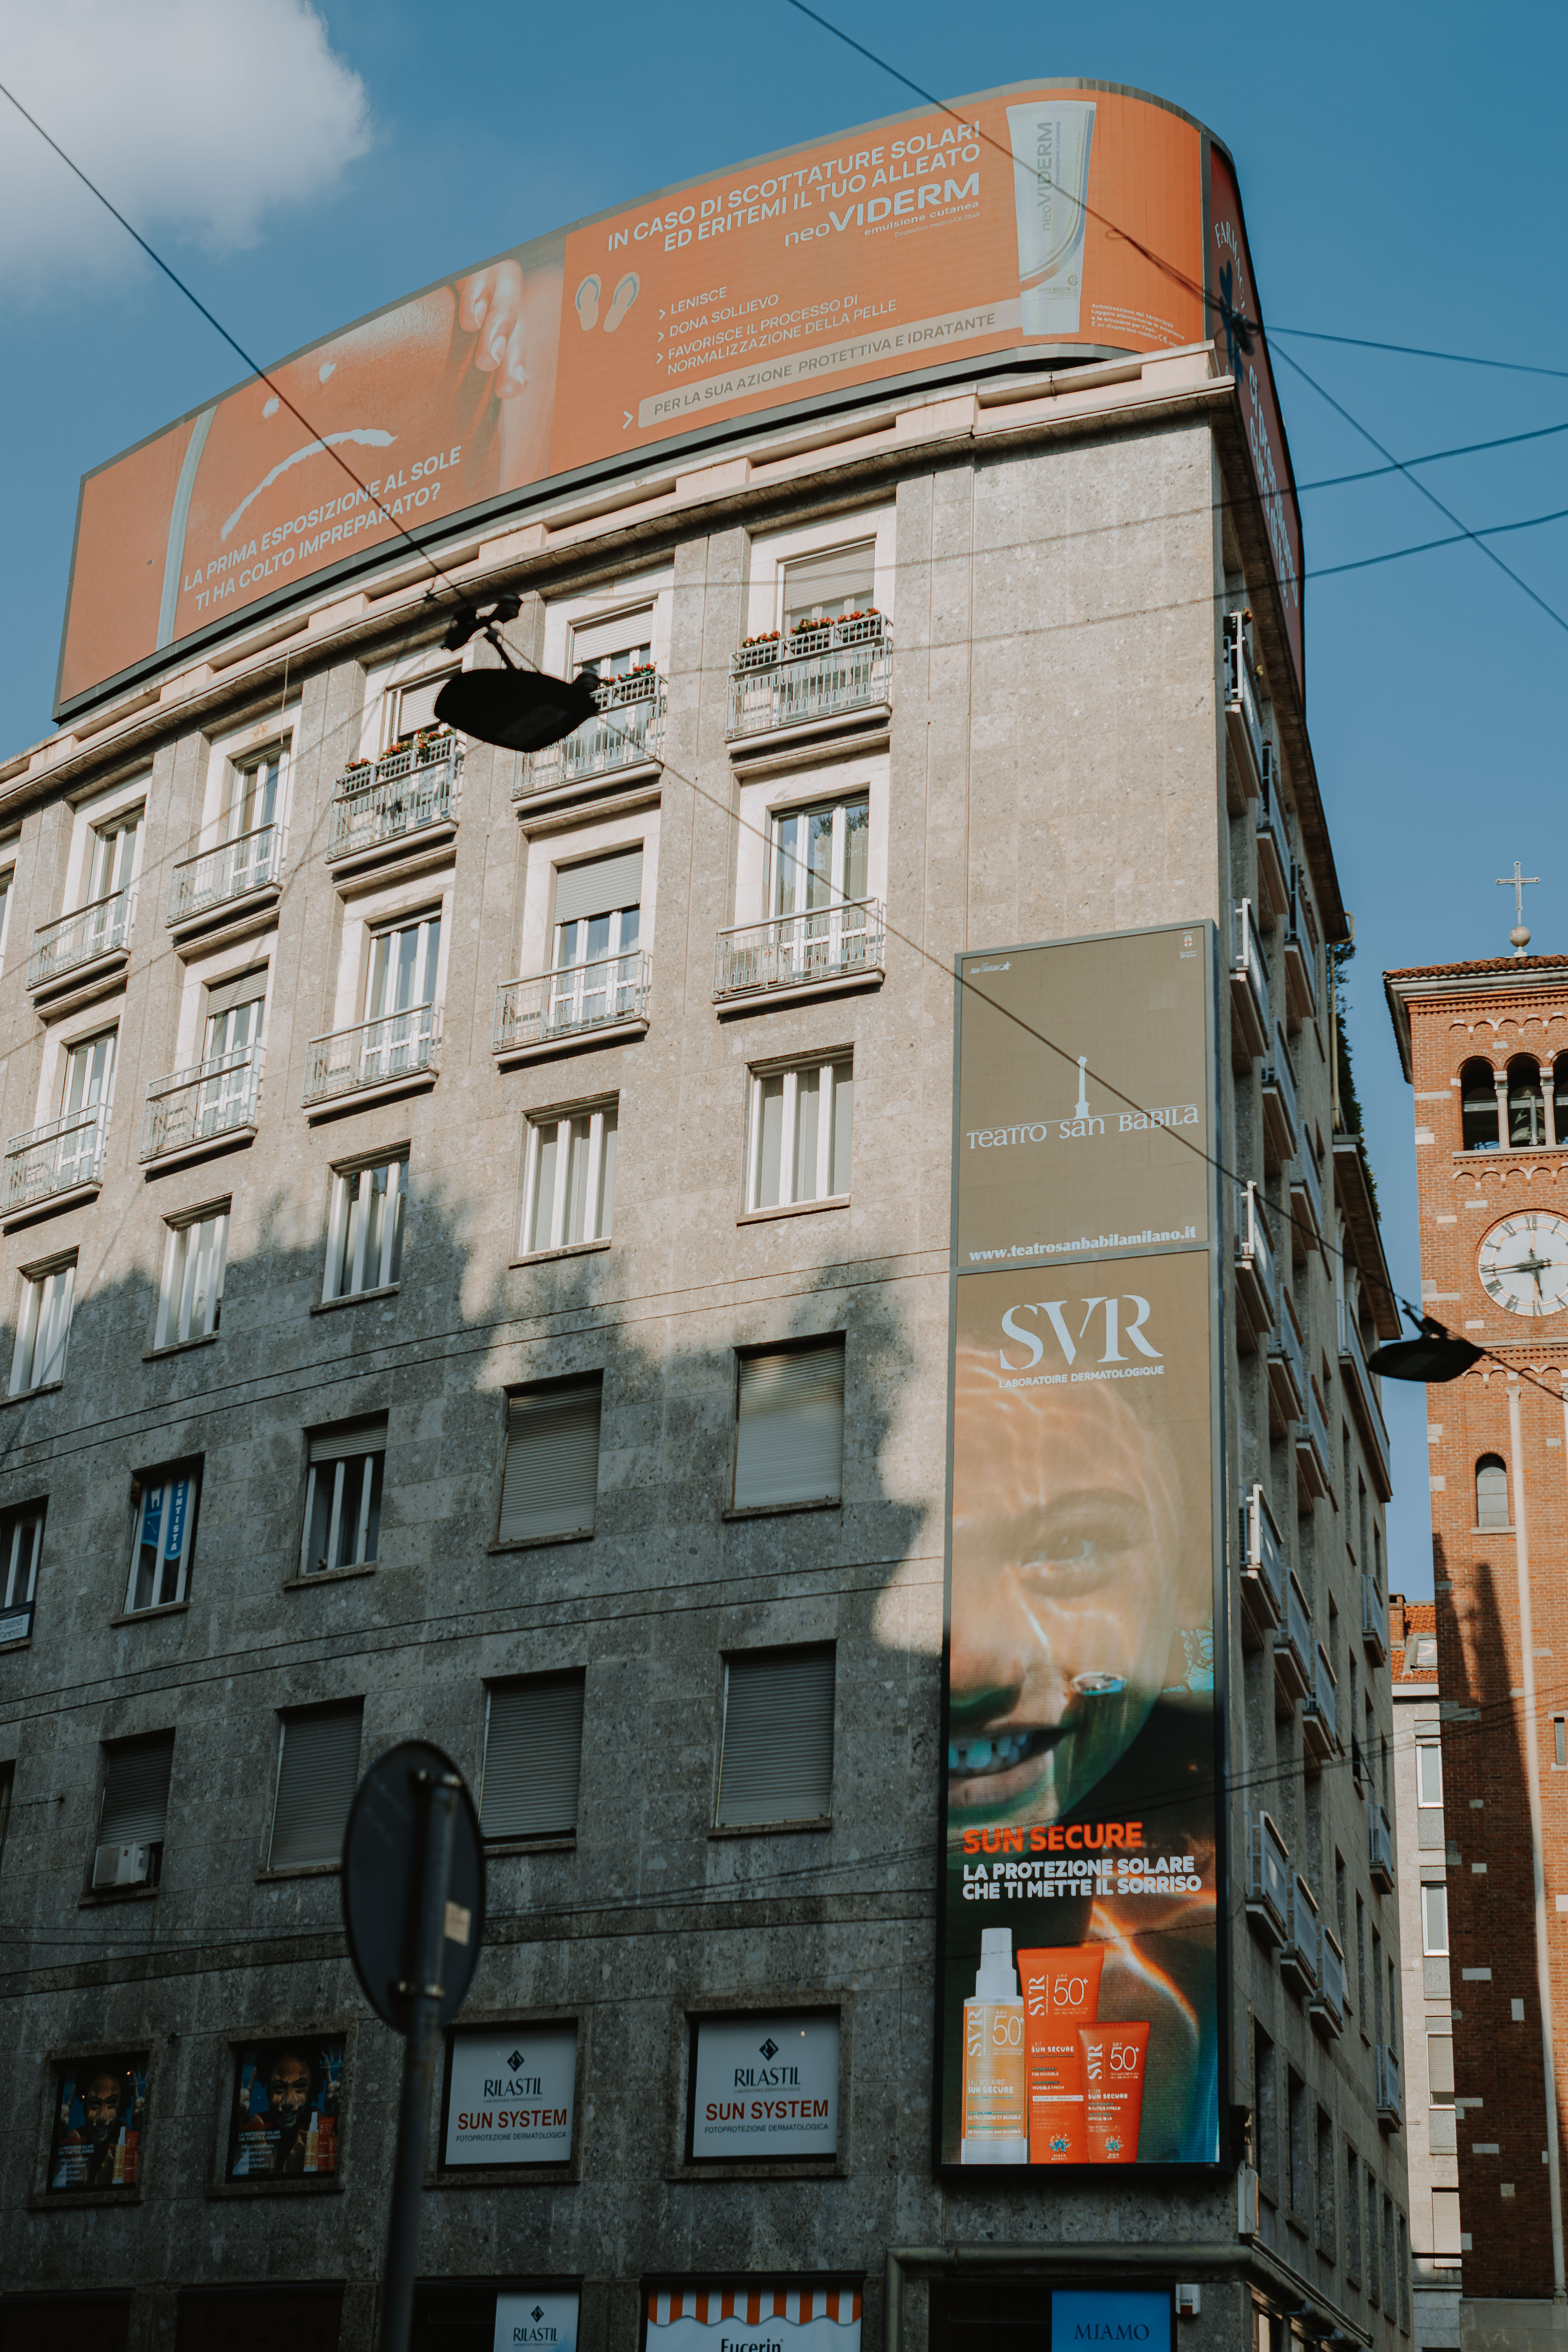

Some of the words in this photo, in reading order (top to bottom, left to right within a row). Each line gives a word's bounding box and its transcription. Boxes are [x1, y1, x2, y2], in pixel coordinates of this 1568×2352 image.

[608, 229, 628, 251] IN
[634, 206, 695, 240] CASO
[701, 196, 721, 218] DI
[728, 146, 885, 208] SCOTTATURE
[890, 120, 980, 159] SOLARI
[665, 228, 692, 252] ED
[698, 196, 787, 240] ERITEMI
[793, 191, 812, 210] IL
[816, 174, 866, 202] TUO
[871, 144, 980, 187] ALLEATO
[785, 172, 979, 247] neoVIDERM
[864, 214, 926, 236] emulsione
[929, 201, 979, 218] cutanea
[669, 315, 708, 338] DONA
[711, 294, 779, 323] SOLLIEVO
[671, 286, 727, 315] LENISCE
[667, 325, 802, 376] NORMALIZZAZIONE
[805, 313, 850, 335] DELLA
[854, 299, 897, 321] PELLE
[668, 326, 744, 360] FAVORISCE
[746, 322, 758, 335] IL
[760, 299, 840, 329] PROCESSO
[844, 294, 858, 308] DI
[654, 397, 681, 415] PER
[684, 392, 701, 407] LA
[704, 382, 733, 399] SUA
[736, 365, 792, 391] AZIONE
[798, 338, 892, 373] PROTETTIVA
[895, 334, 904, 346] E
[907, 313, 995, 344] IDRATANTE
[184, 568, 202, 591] LA
[207, 539, 257, 579] PRIMA
[261, 480, 380, 551] ESPOSIZIONE
[383, 470, 407, 493] AL
[410, 446, 461, 481] SOLE
[195, 589, 210, 610] TI
[213, 577, 236, 601] HA
[239, 547, 295, 587] COLTO
[299, 482, 441, 559] IMPREPARATO?
[969, 1225, 1197, 1261] www.teatrosanbabilamilano.it
[1000, 1294, 1164, 1370] SVR
[998, 1374, 1068, 1388] LABORATOIRE
[1070, 1365, 1165, 1381] DERMATOLOGIQUE
[170, 1480, 184, 1551] DENTISTA
[963, 1826, 1023, 1854] SUN
[1030, 1822, 1143, 1852] SECURE
[963, 1863, 988, 1881] LA
[993, 1858, 1113, 1880] PROTEZIONE
[1117, 1856, 1195, 1875] SOLARE
[962, 1882, 1000, 1900] CHE
[1004, 1882, 1023, 1898] TI
[1027, 1879, 1092, 1897] METTE
[1096, 1878, 1114, 1895] IL
[1117, 1875, 1202, 1894] SORRISO
[1029, 1975, 1045, 2016] SVR
[968, 2008, 983, 2057] SVR
[734, 2066, 801, 2087] RILASTIL
[1088, 2043, 1102, 2079] SVR
[484, 2077, 543, 2097] RILASTIL
[458, 2112, 493, 2131] SUN
[498, 2109, 567, 2128] SYSTEM
[704, 2124, 766, 2134] FOTOPROTEZIONE
[769, 2122, 828, 2132] DERMATOLOGICA
[706, 2102, 745, 2121] SUN
[751, 2099, 828, 2119] SYSTEM
[456, 2133, 511, 2142] FOTOPROTEZIONE
[513, 2131, 567, 2140] DERMATOLOGICA
[513, 2328, 558, 2341] RILASTIL
[1074, 2323, 1149, 2341] MIAMO
